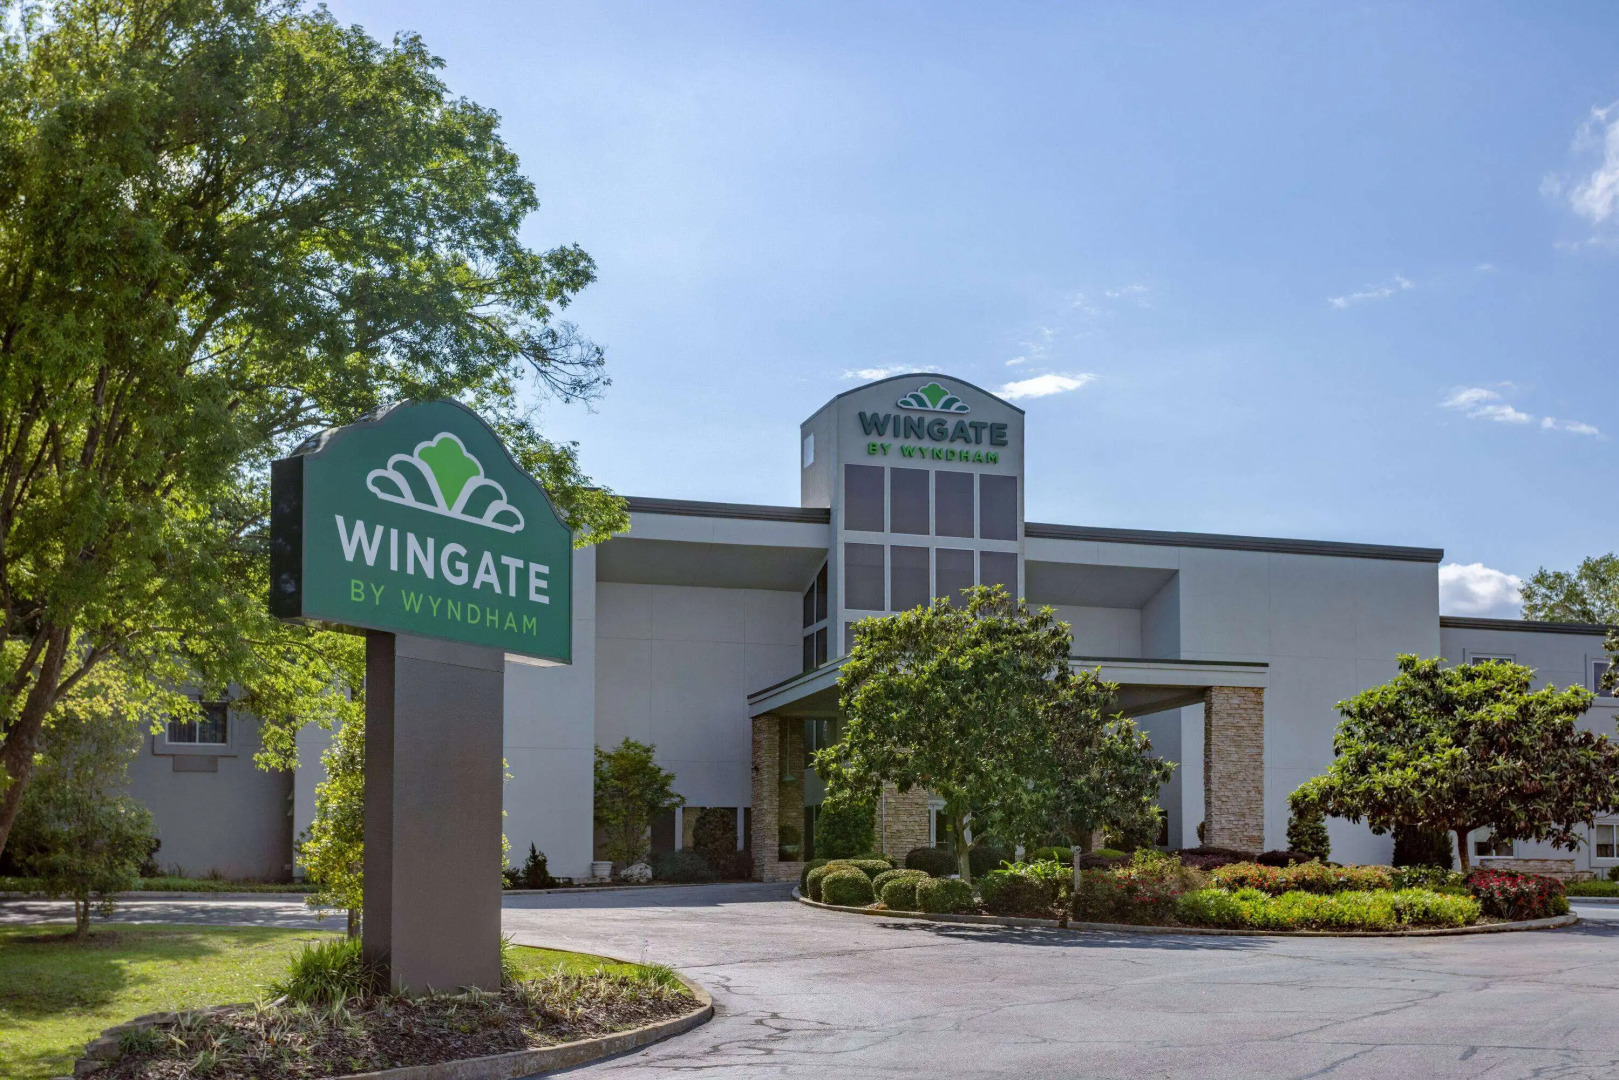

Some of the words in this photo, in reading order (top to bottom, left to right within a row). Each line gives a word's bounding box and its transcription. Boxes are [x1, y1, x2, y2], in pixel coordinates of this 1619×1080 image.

[858, 411, 1009, 446] WINGATE
[867, 441, 892, 456] BY
[900, 444, 1000, 464] WYNDHAM
[335, 514, 550, 605] WINGATE
[350, 579, 385, 606] BY
[401, 589, 537, 636] WYNDHAM
